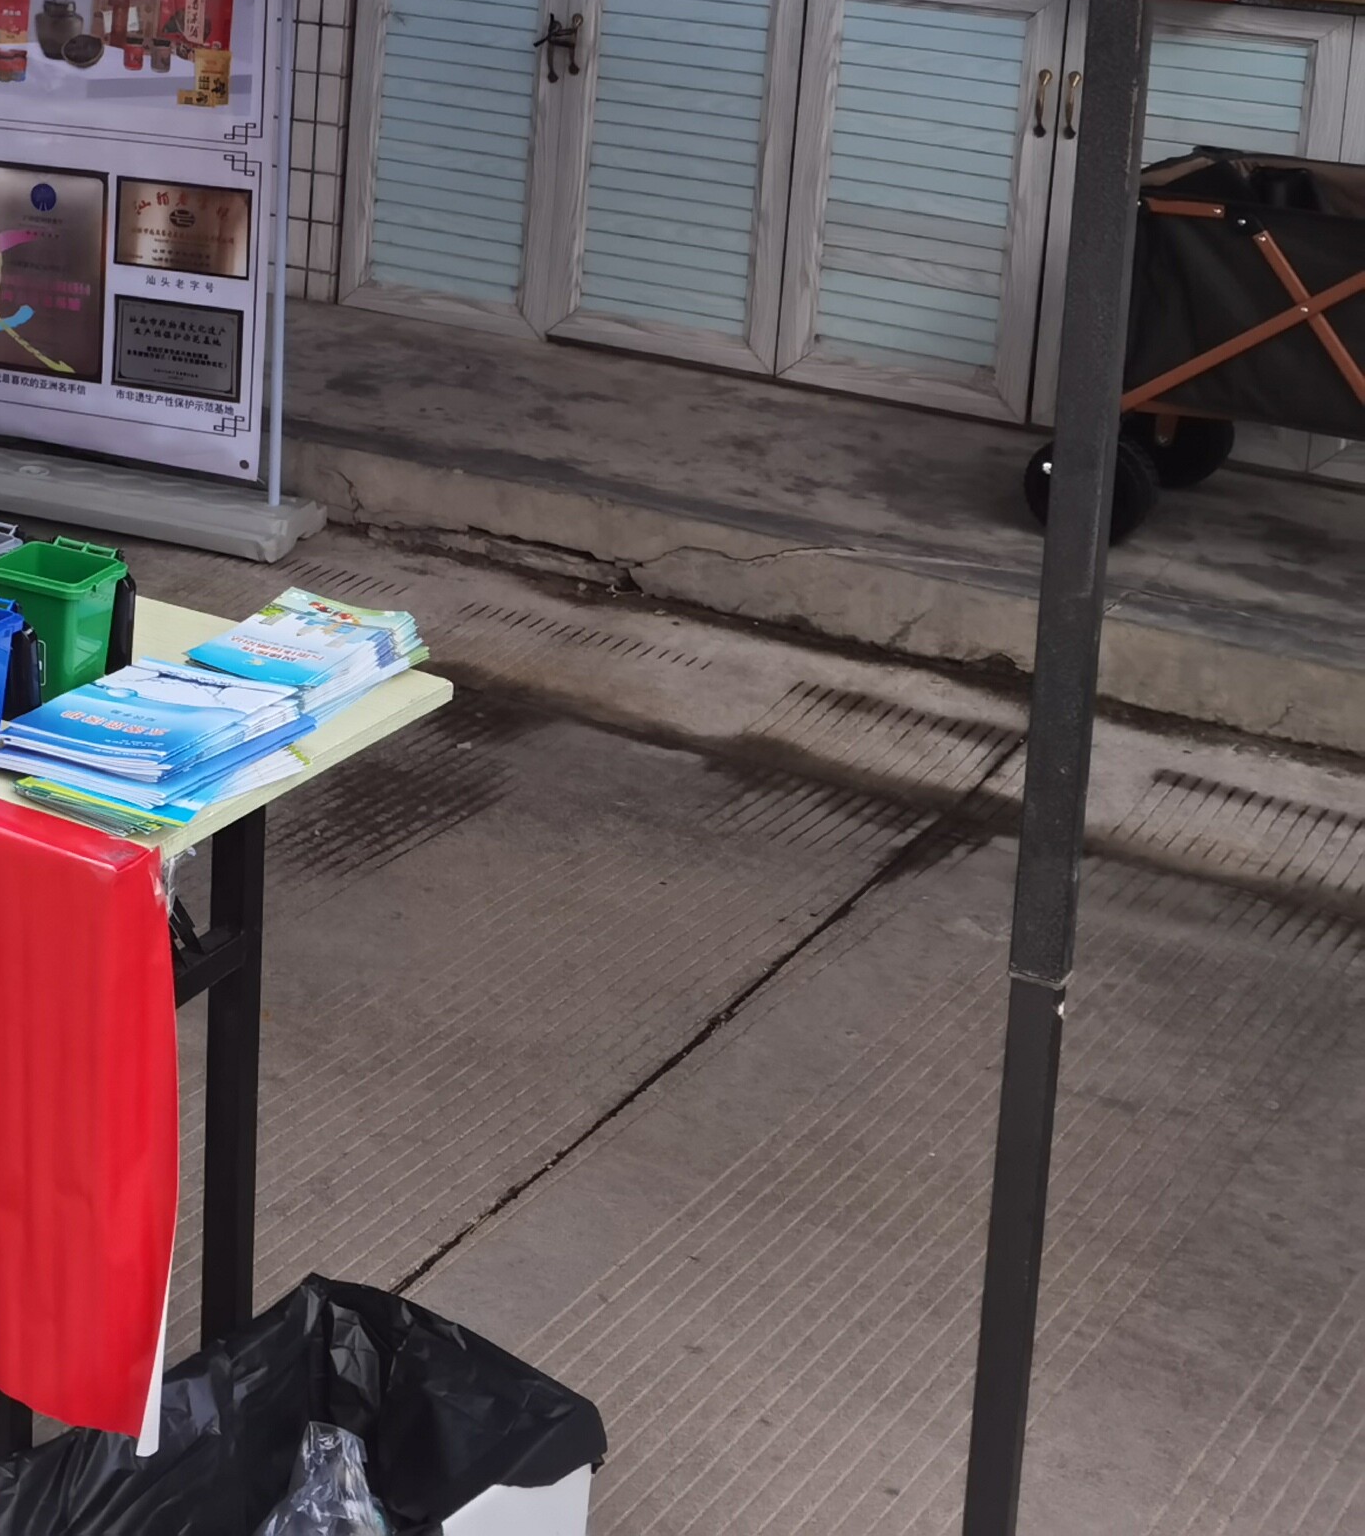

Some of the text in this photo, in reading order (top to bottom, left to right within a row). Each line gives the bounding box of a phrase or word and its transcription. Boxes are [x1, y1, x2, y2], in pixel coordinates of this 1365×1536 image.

[146, 275, 214, 293] 汕头老字号
